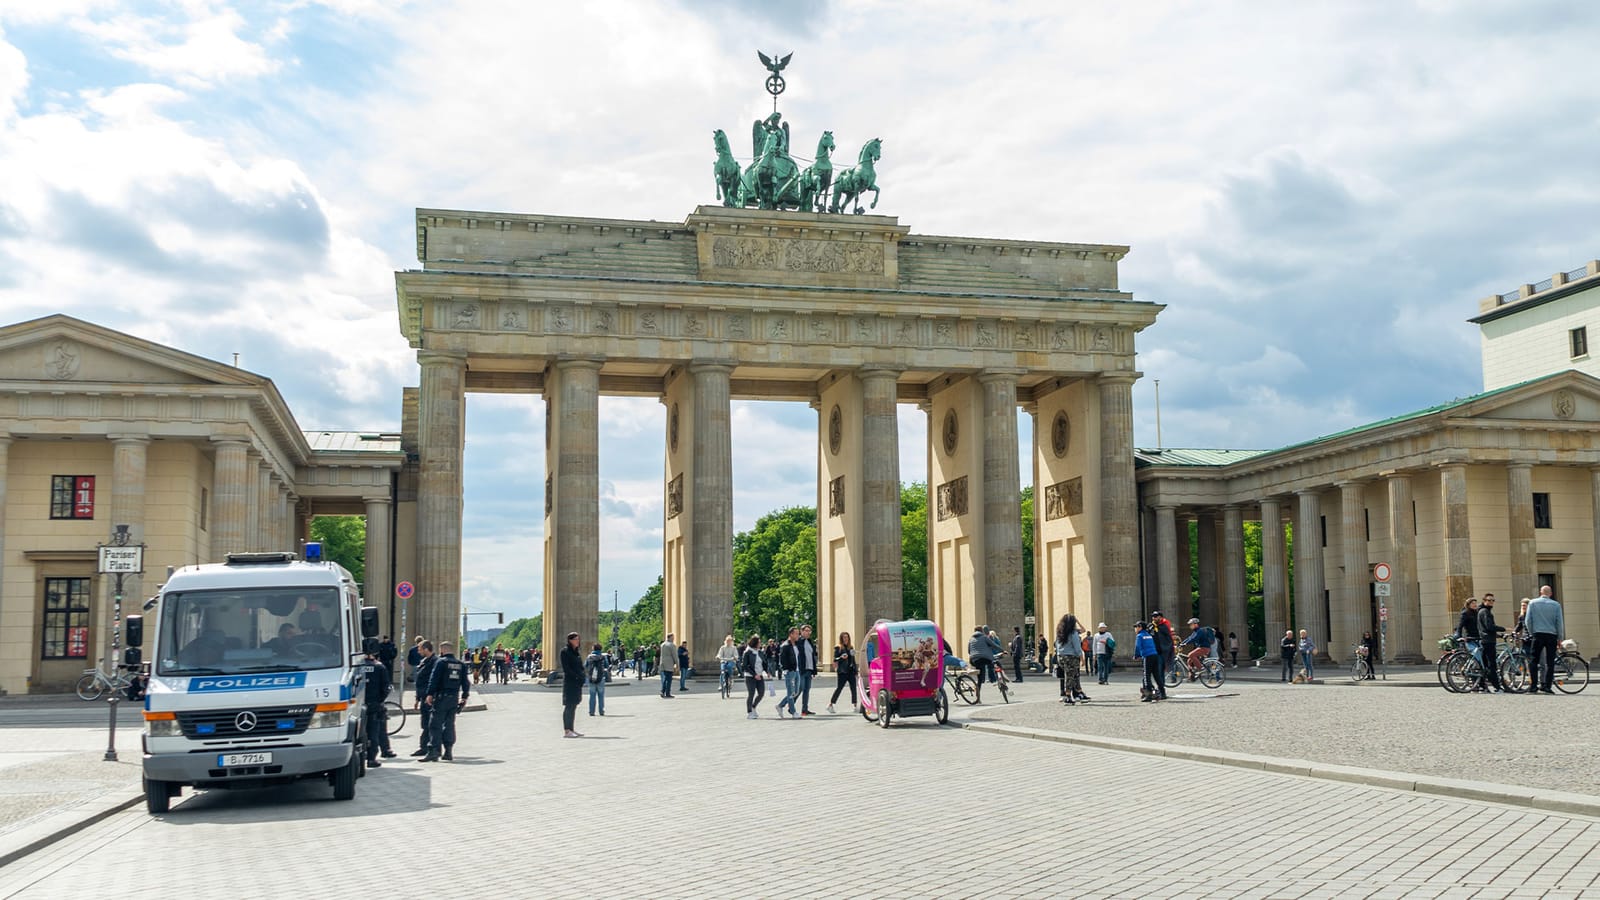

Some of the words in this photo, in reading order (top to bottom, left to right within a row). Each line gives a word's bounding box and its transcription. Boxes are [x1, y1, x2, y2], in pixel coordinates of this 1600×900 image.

[104, 549, 137, 559] Pariser
[109, 560, 131, 570] Platz
[198, 676, 296, 689] POLIZEI
[314, 688, 330, 698] 15
